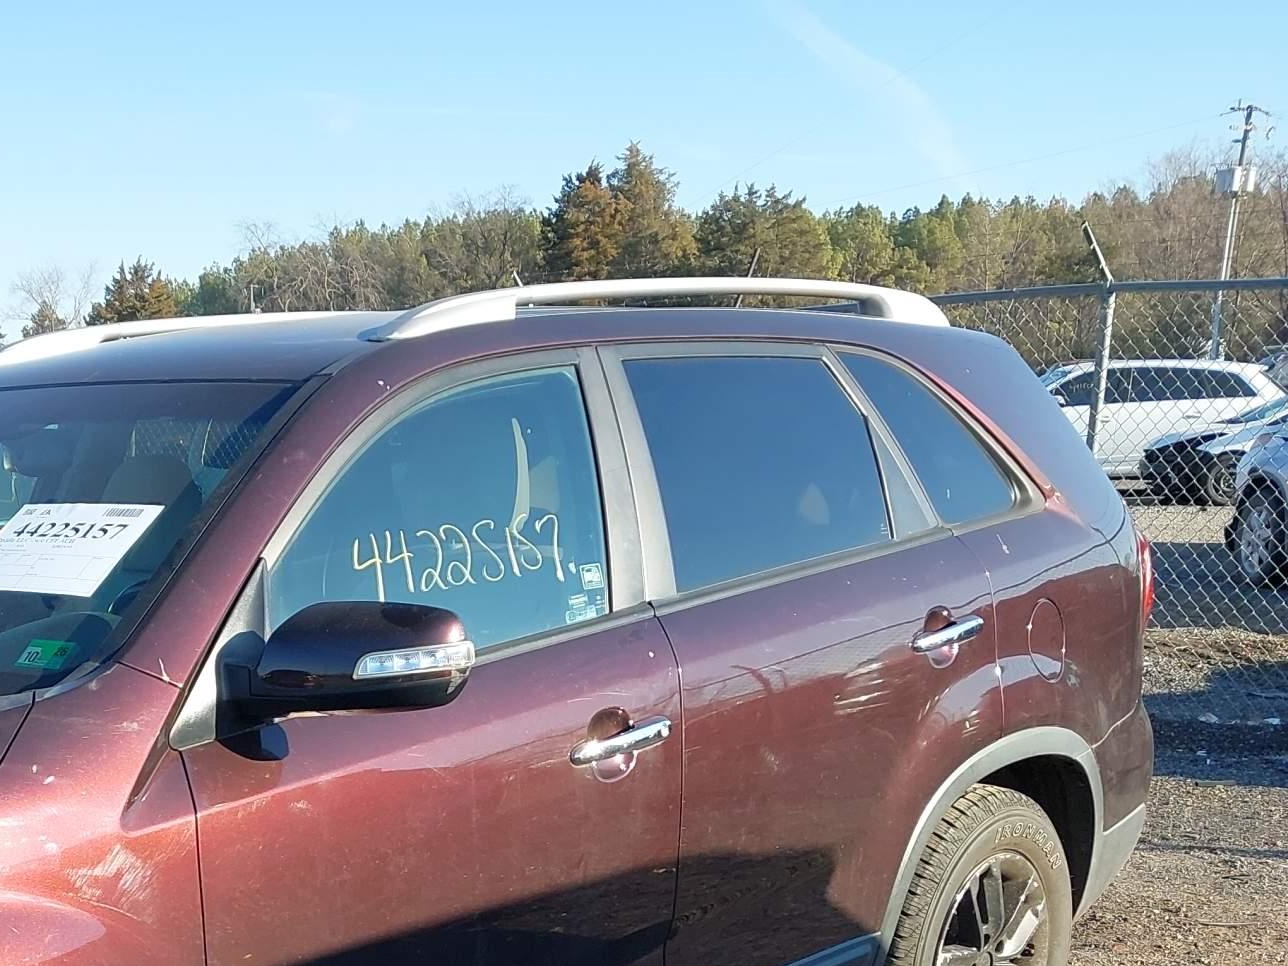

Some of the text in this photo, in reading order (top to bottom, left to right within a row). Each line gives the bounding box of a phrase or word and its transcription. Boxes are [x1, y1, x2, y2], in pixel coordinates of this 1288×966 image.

[13, 521, 130, 540] 44225157
[352, 512, 565, 602] 44225157
[23, 650, 40, 663] 10
[994, 822, 1063, 870] IRONMAN
